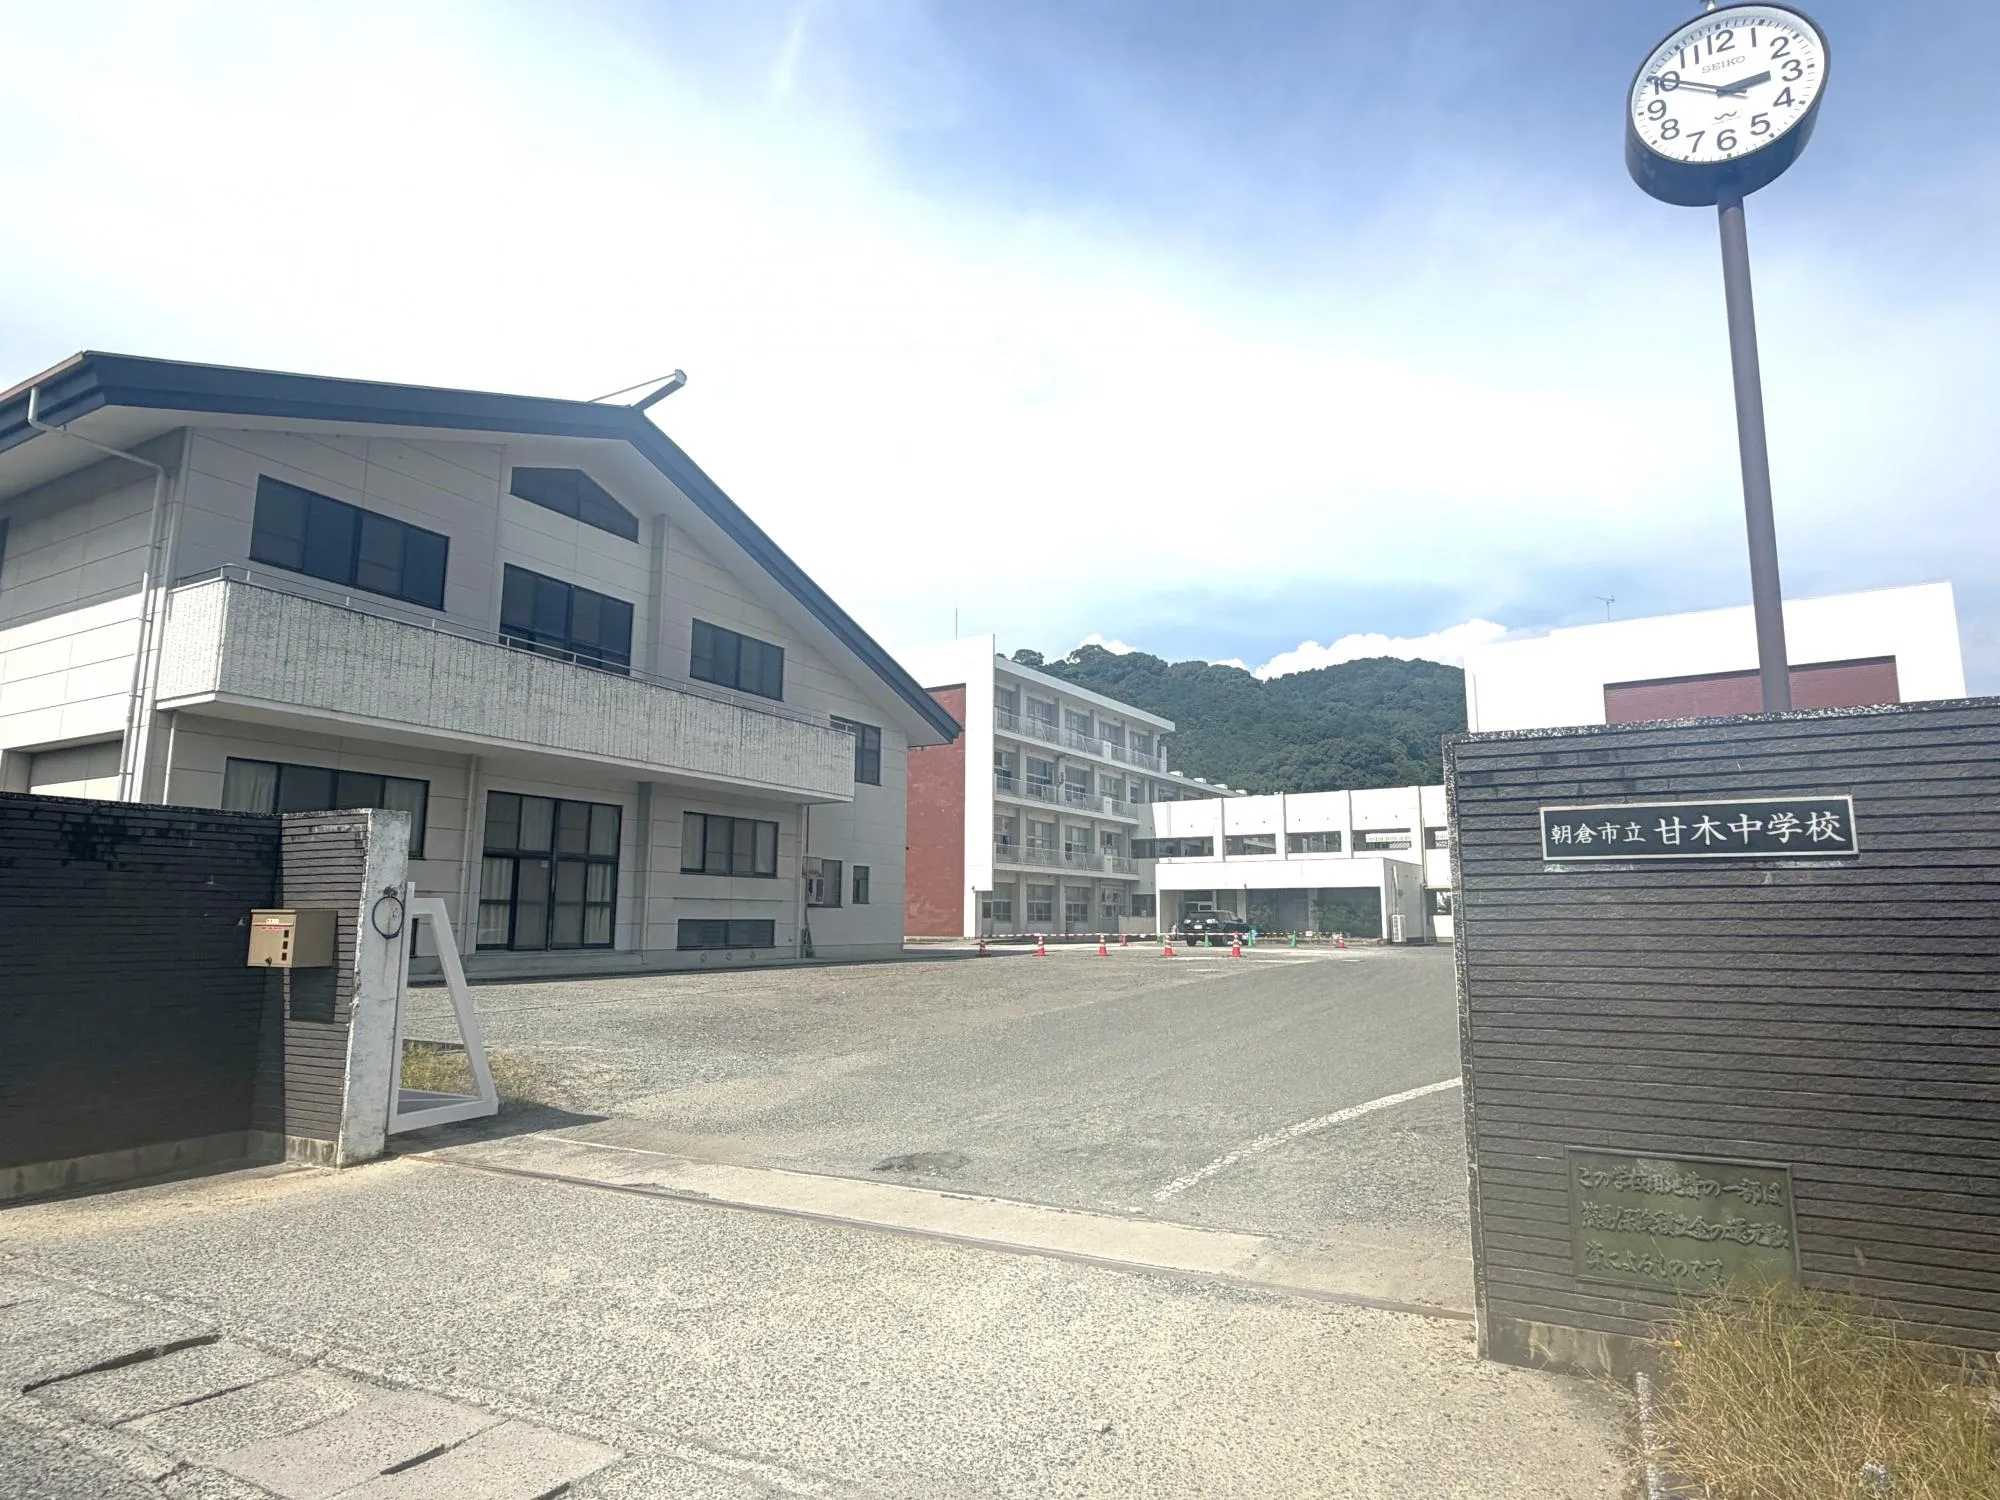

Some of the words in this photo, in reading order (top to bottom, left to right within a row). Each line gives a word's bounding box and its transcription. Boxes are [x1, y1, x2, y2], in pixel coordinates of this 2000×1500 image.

[1707, 29, 1735, 56] 12
[1751, 27, 1757, 48] 1
[1769, 36, 1791, 60] 2
[1680, 44, 1700, 69] 11
[1701, 55, 1746, 75] SEIKO
[1781, 59, 1803, 82] 3
[1650, 70, 1681, 96] 10
[1772, 86, 1795, 109] 4
[1647, 99, 1667, 122] 9
[1660, 118, 1680, 141] 8
[1750, 112, 1771, 136] 5
[1686, 130, 1706, 153] 7
[1716, 128, 1738, 151] 6
[1549, 822, 1647, 846] 朝倉市立
[1653, 811, 1846, 847] 甘木中学校
